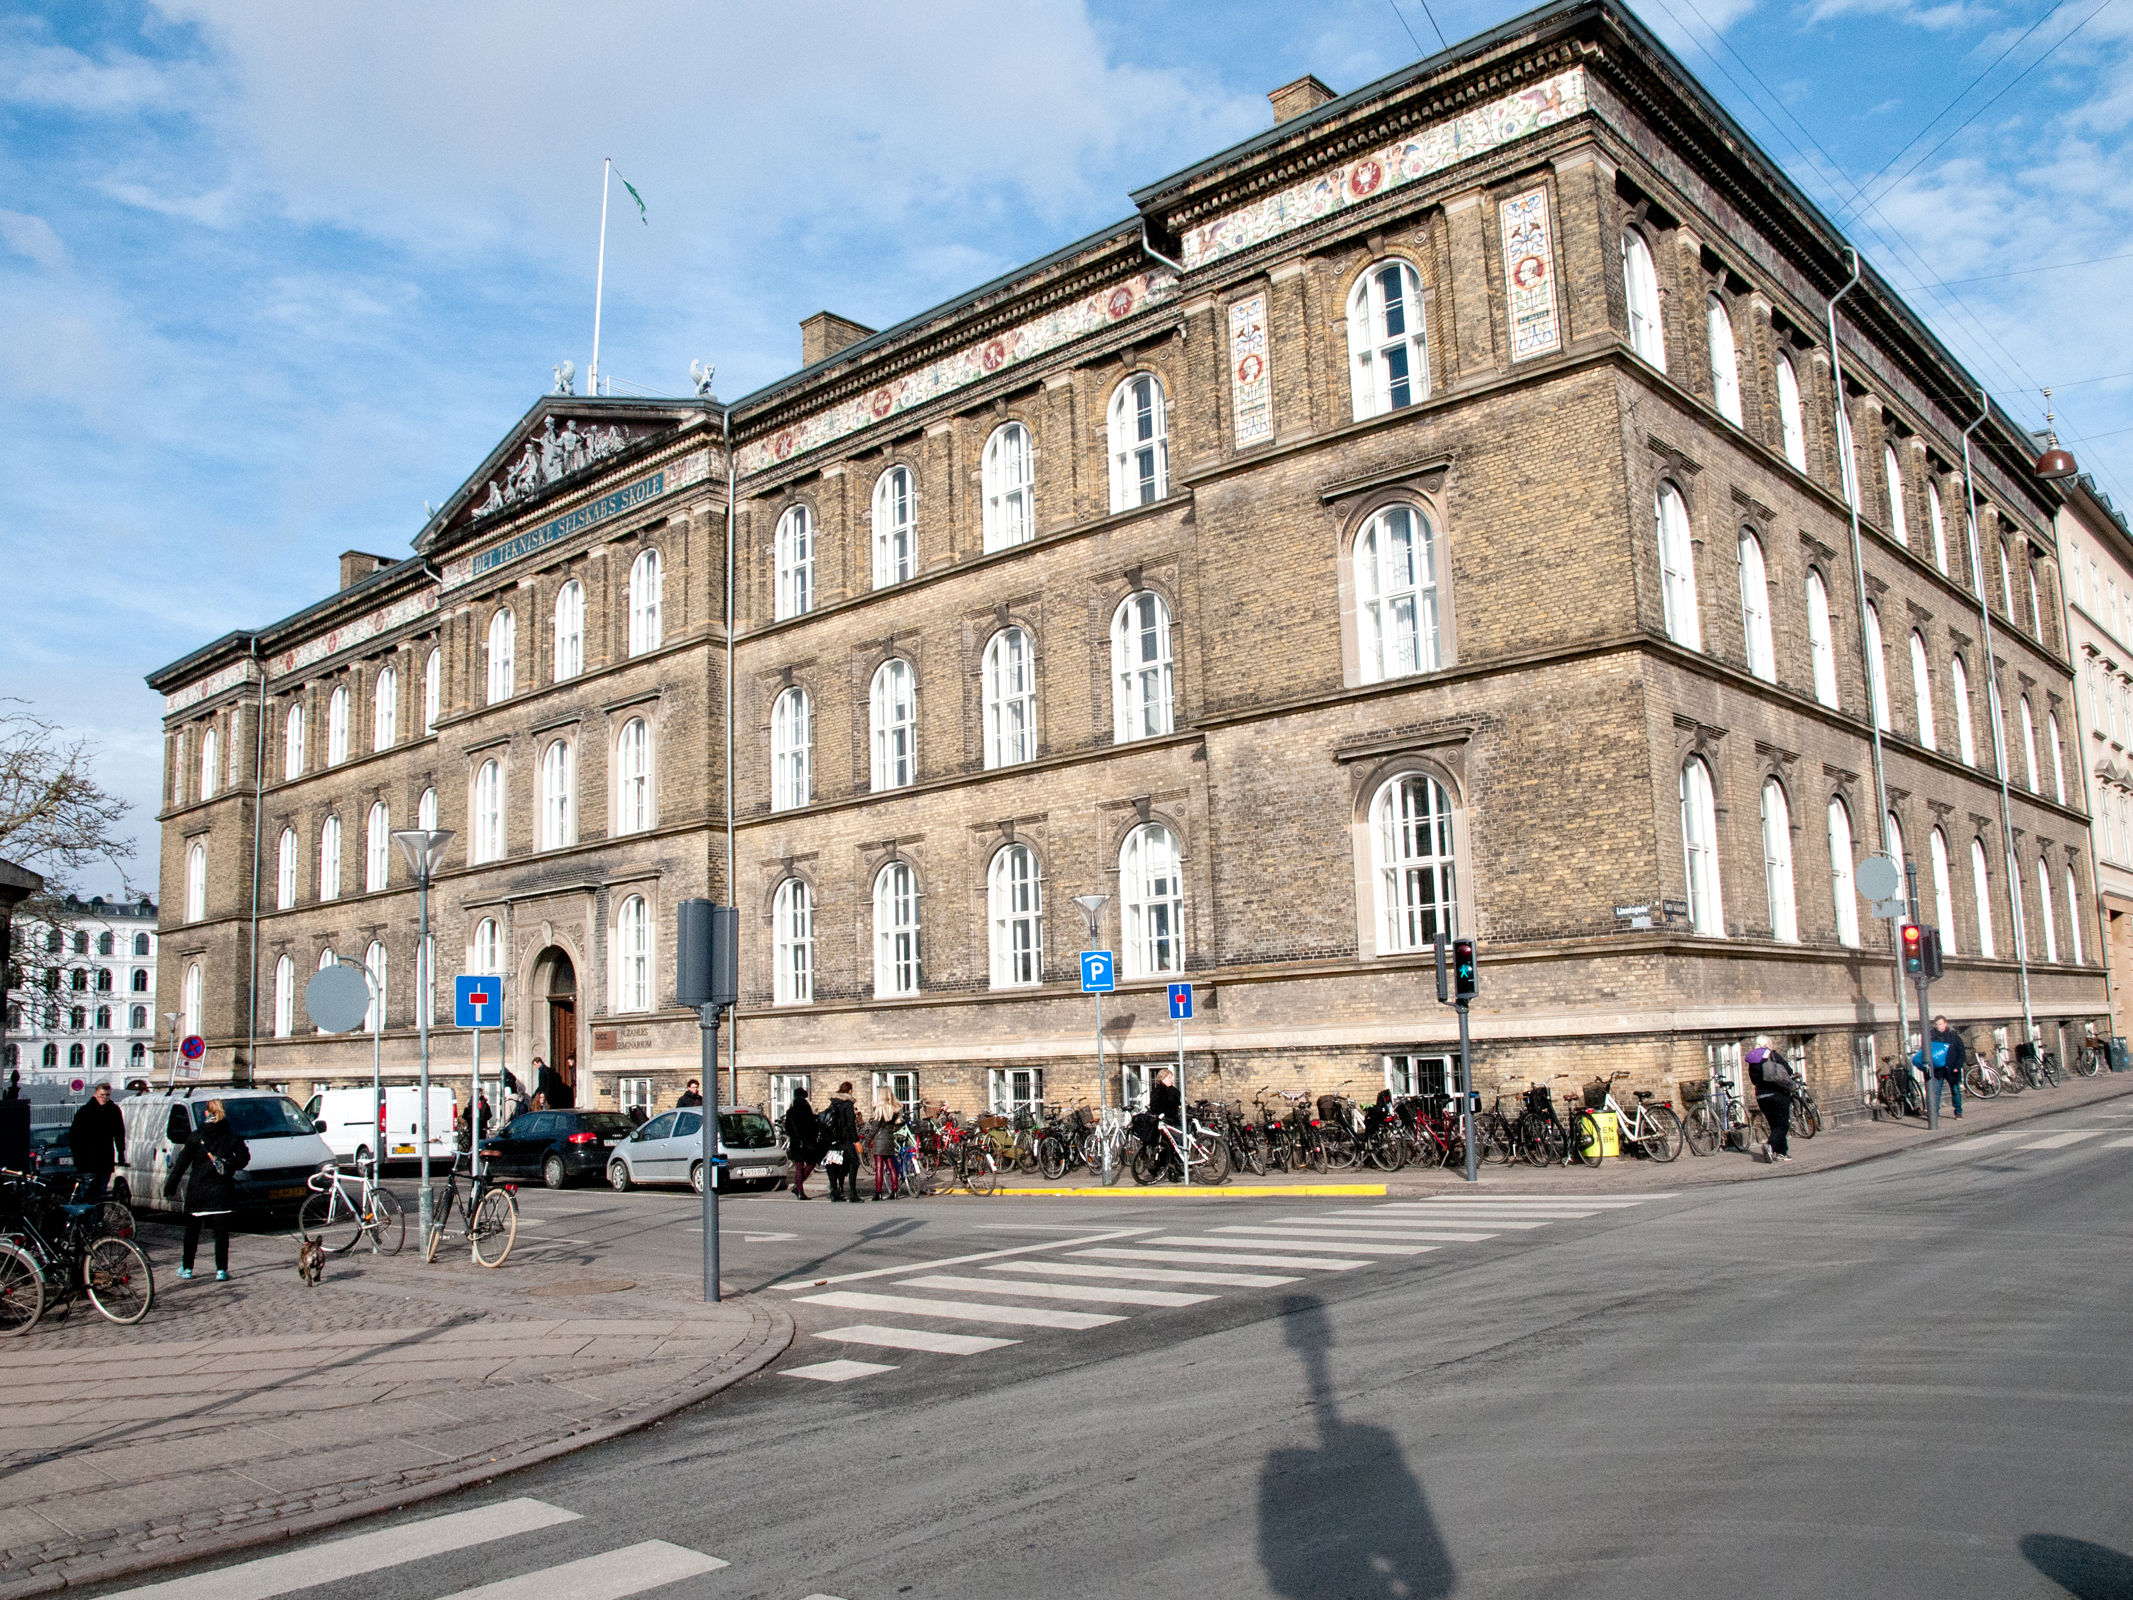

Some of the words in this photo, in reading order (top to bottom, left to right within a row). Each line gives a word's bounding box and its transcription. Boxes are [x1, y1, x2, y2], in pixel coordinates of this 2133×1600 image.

[475, 554, 494, 572] DET
[498, 525, 553, 561] TEKNISKE
[558, 497, 616, 537] SELSKABS
[621, 476, 661, 509] SKOLE
[1091, 962, 1104, 981] P
